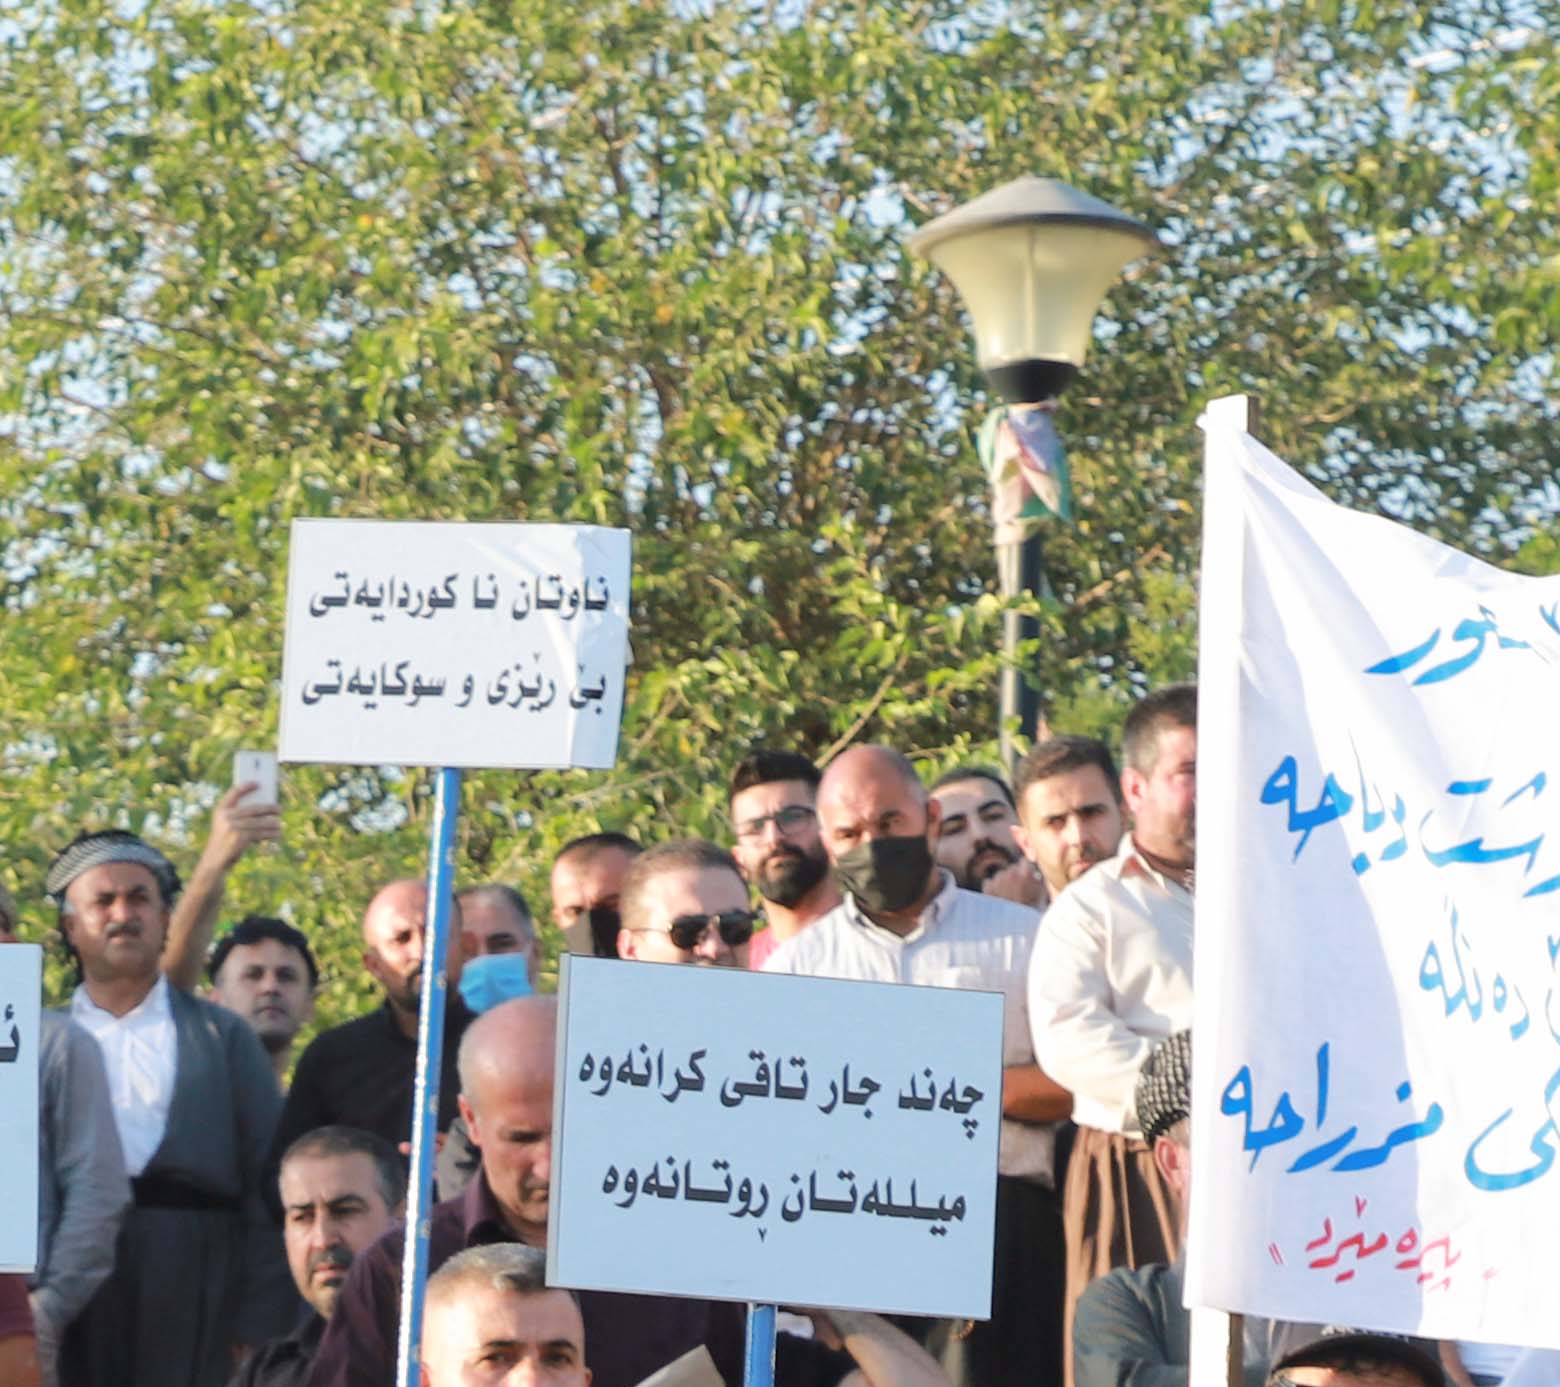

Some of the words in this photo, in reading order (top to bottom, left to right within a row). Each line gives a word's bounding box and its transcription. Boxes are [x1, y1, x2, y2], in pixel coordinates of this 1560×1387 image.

[473, 573, 499, 610] نا
[511, 575, 611, 622] ناوتان
[455, 674, 475, 709] و
[569, 663, 607, 716] بێ
[578, 1043, 707, 1104] کرانەوە
[719, 1050, 809, 1108] تاقی
[817, 1063, 882, 1120] جار
[897, 1067, 985, 1141] چەند
